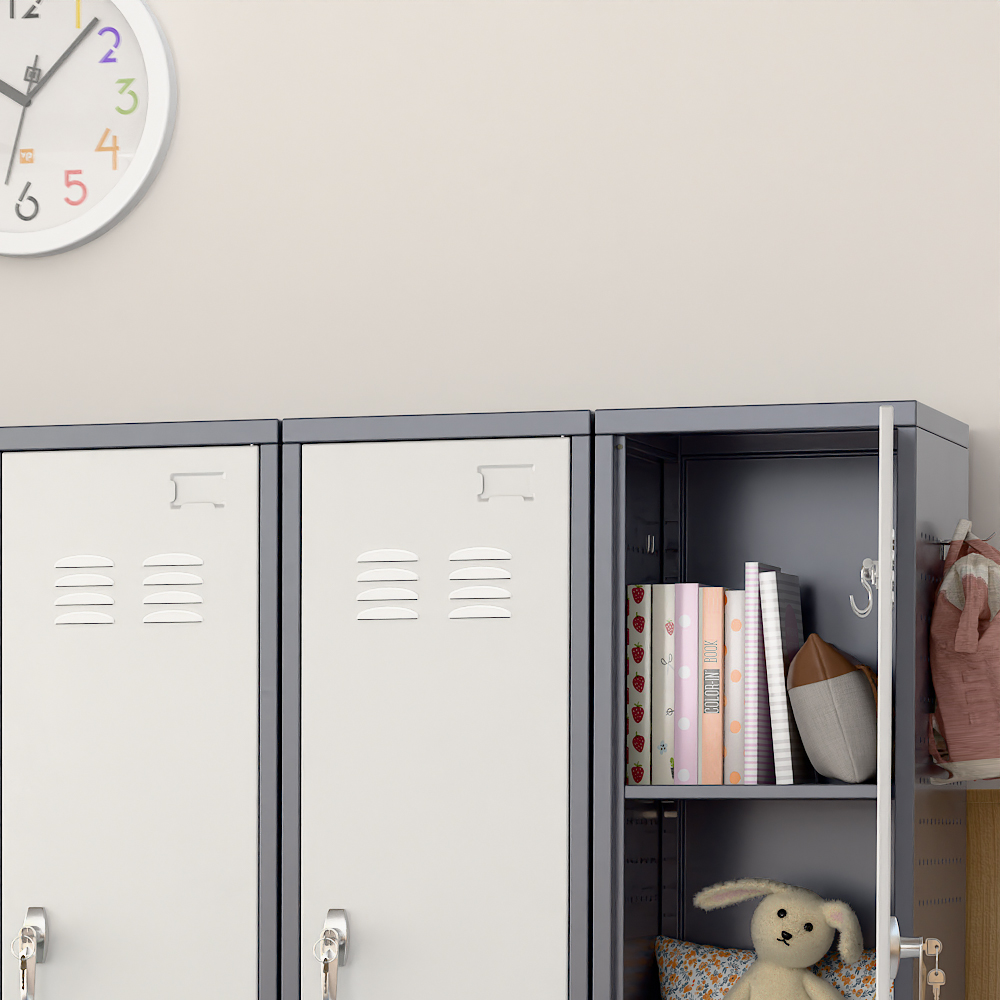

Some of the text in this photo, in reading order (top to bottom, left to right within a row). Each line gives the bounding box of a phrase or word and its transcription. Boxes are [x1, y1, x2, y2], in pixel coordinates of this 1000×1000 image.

[75, 0, 82, 29] 1
[97, 26, 121, 63] 2
[115, 78, 139, 115] 3
[94, 128, 120, 170] 4
[15, 181, 39, 221] 6
[64, 169, 88, 206] 5
[704, 640, 718, 663] BOOK
